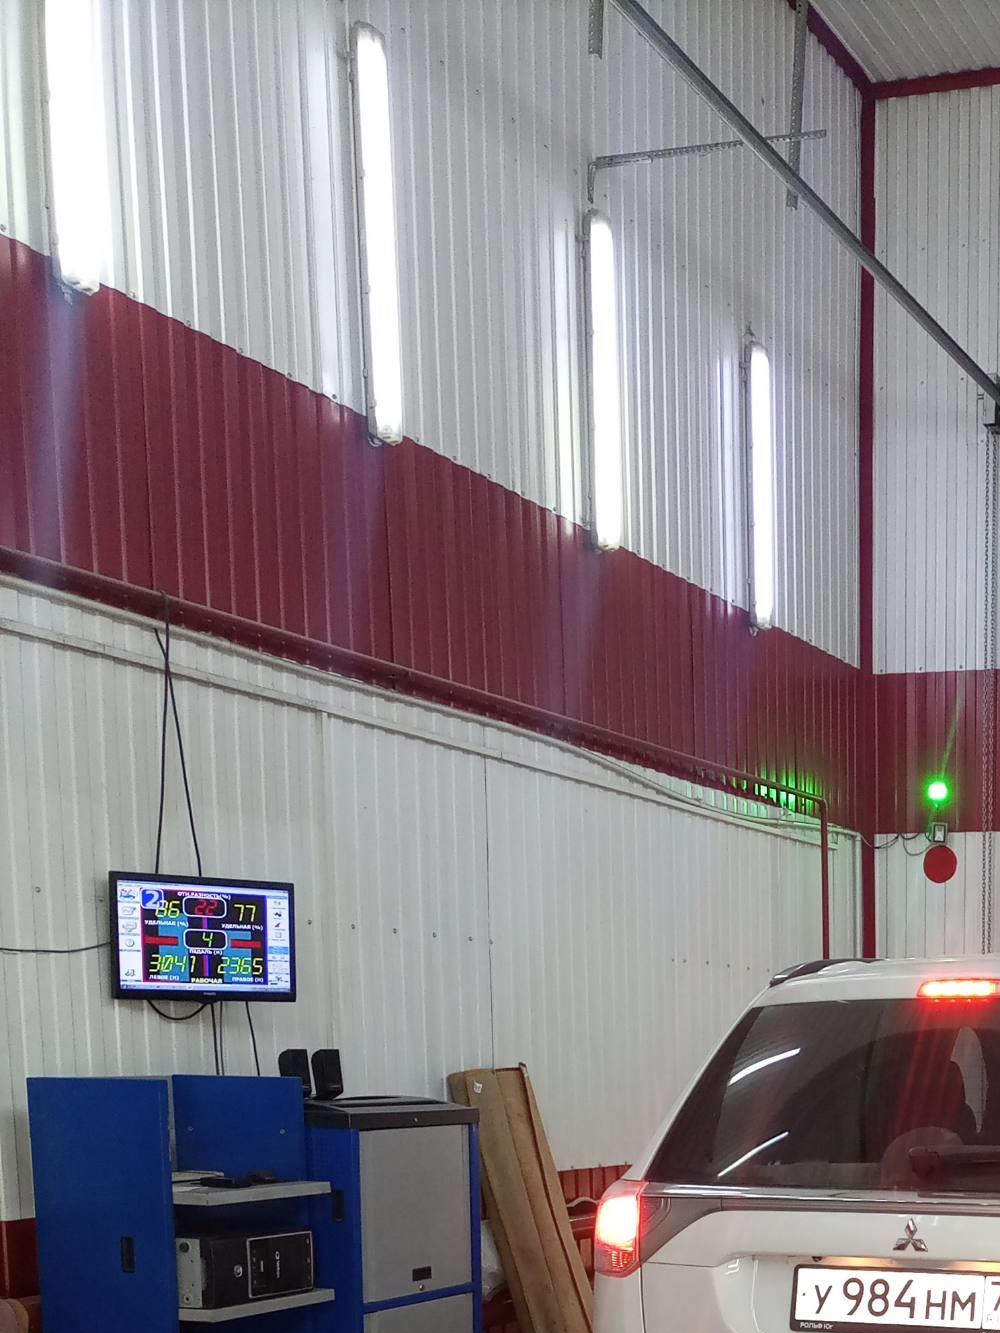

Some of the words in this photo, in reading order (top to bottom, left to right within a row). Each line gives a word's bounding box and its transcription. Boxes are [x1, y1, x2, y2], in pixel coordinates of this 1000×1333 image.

[145, 890, 160, 907] 2
[195, 900, 218, 915] 22
[234, 904, 256, 922] 77
[202, 932, 213, 948] 4
[217, 957, 263, 975] 2365
